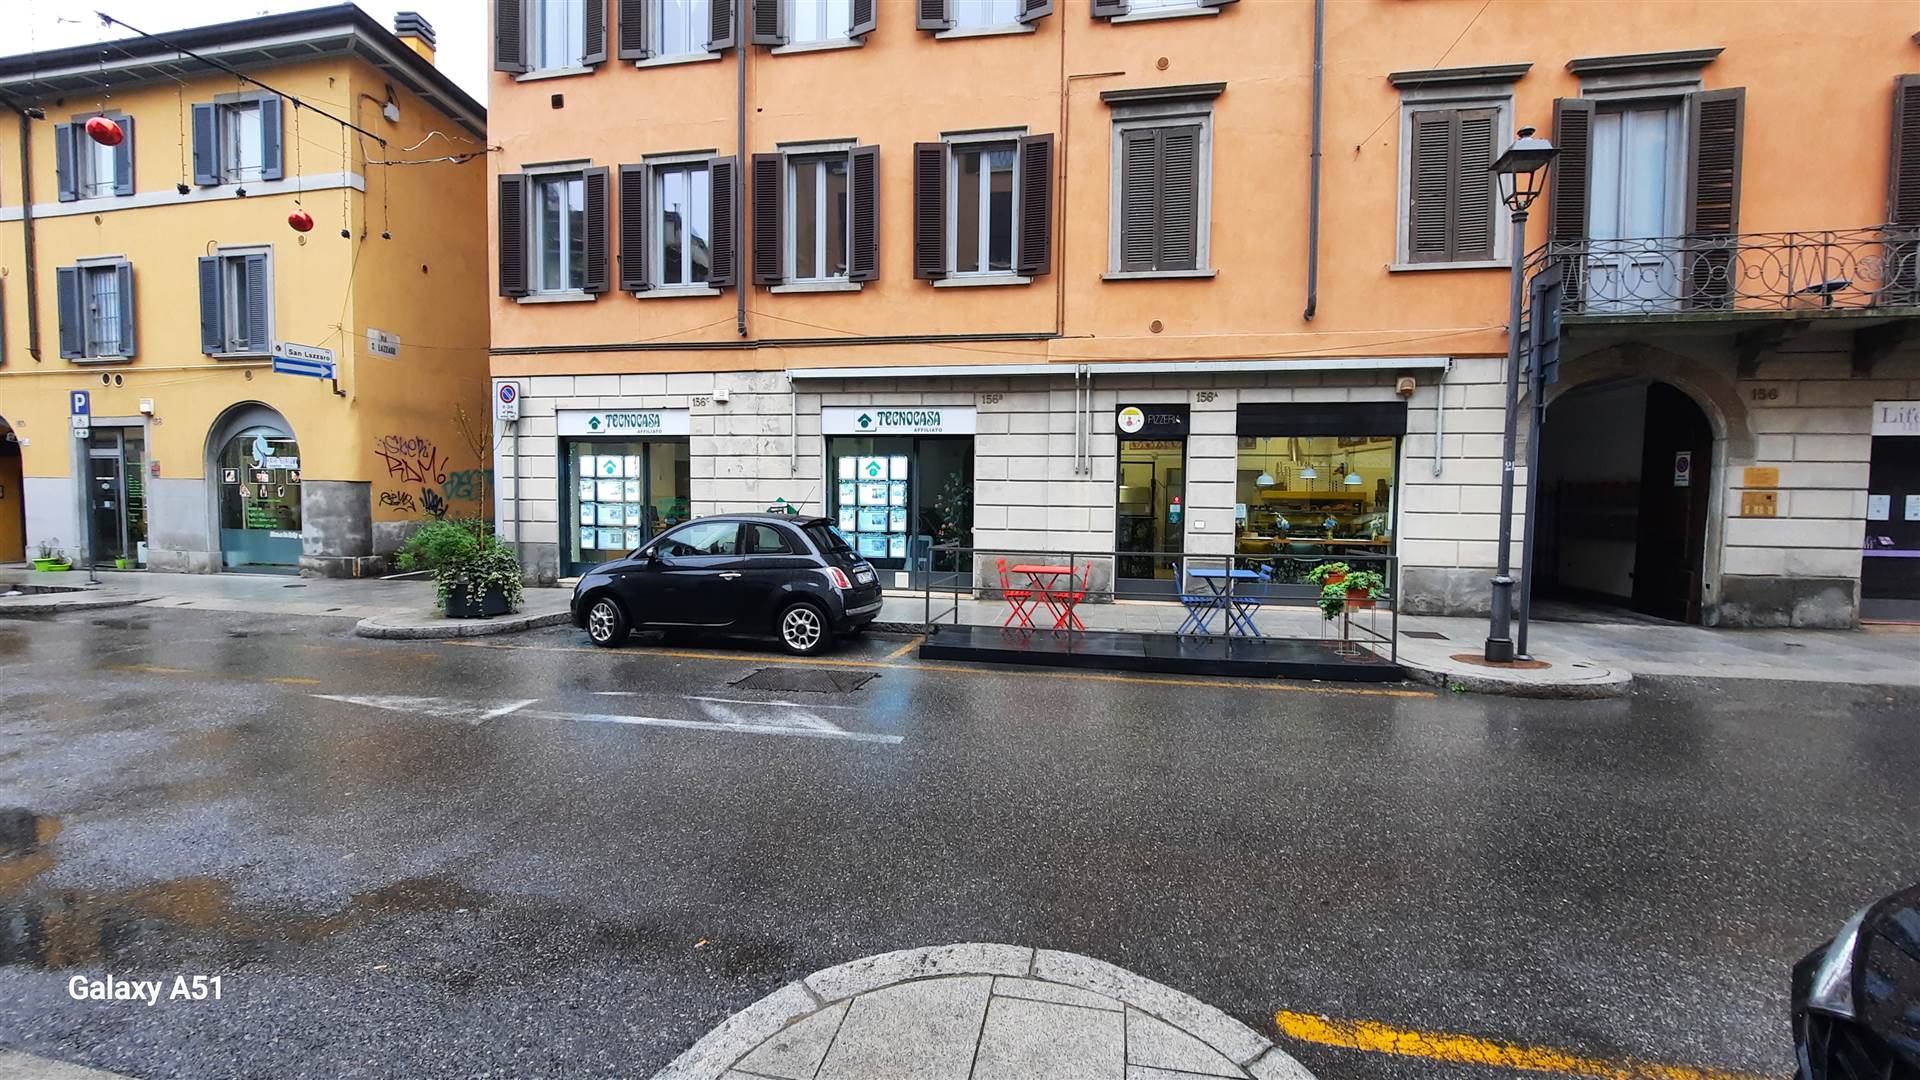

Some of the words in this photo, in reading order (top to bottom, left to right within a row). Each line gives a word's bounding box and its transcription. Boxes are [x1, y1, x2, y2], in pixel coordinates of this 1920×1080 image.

[288, 348, 303, 357] San
[304, 351, 331, 361] Lazzaro
[1752, 388, 1778, 400] 156
[74, 393, 86, 413] P
[605, 413, 661, 428] TECNOCASA
[877, 411, 941, 427] TECNOCASA
